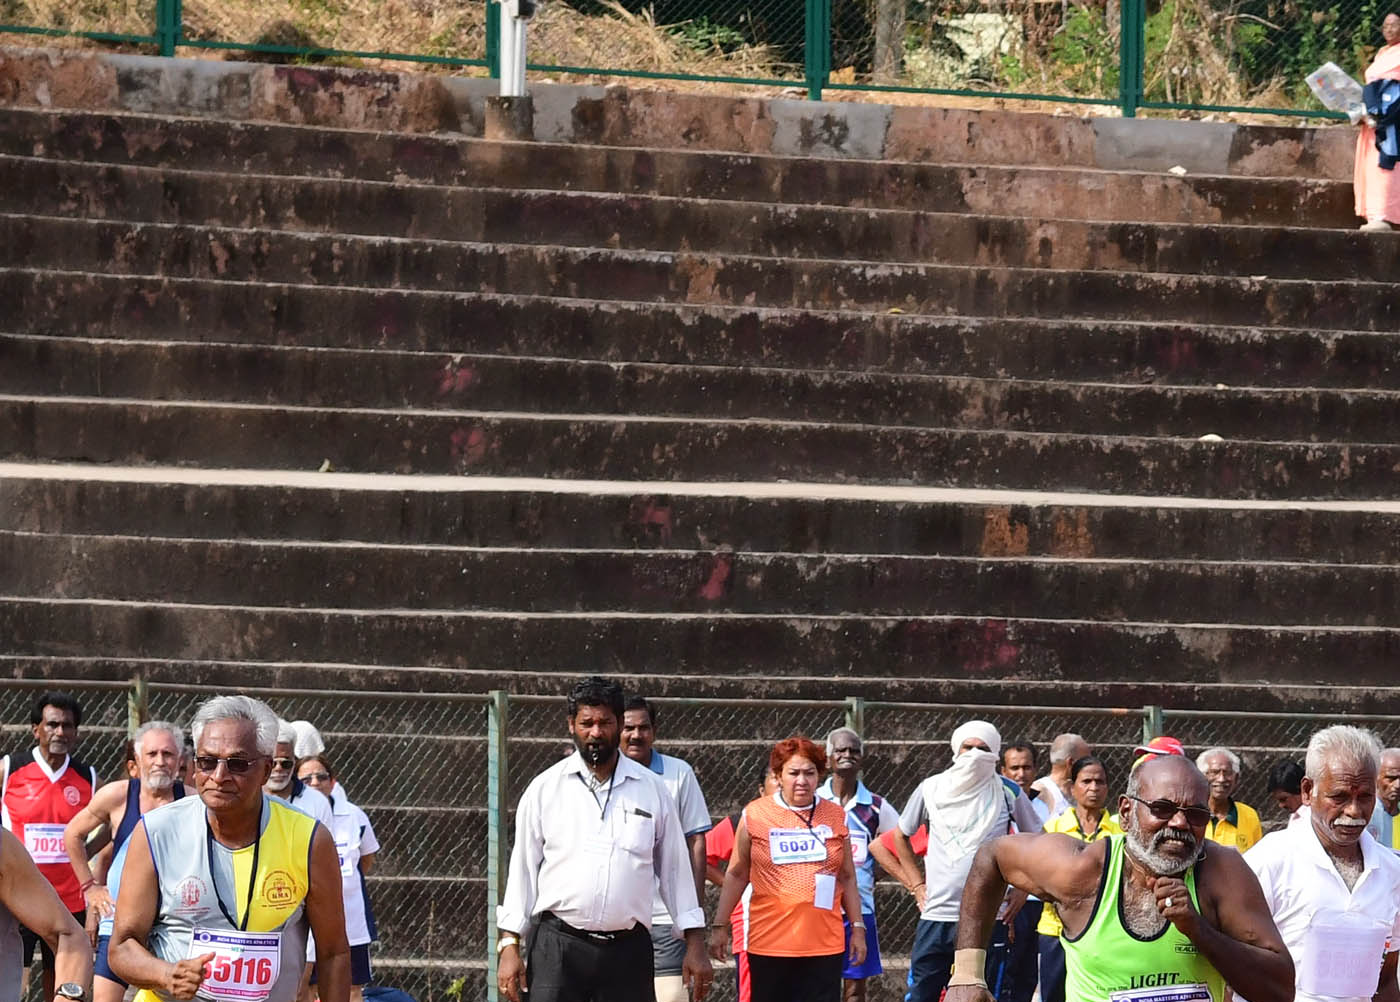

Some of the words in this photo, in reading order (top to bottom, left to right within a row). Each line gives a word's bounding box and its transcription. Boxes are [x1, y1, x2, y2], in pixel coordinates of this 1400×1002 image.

[1130, 972, 1180, 989] LIGHT
[1153, 995, 1179, 1002] MASTERS
[1180, 992, 1207, 1001] ATHLETICS
